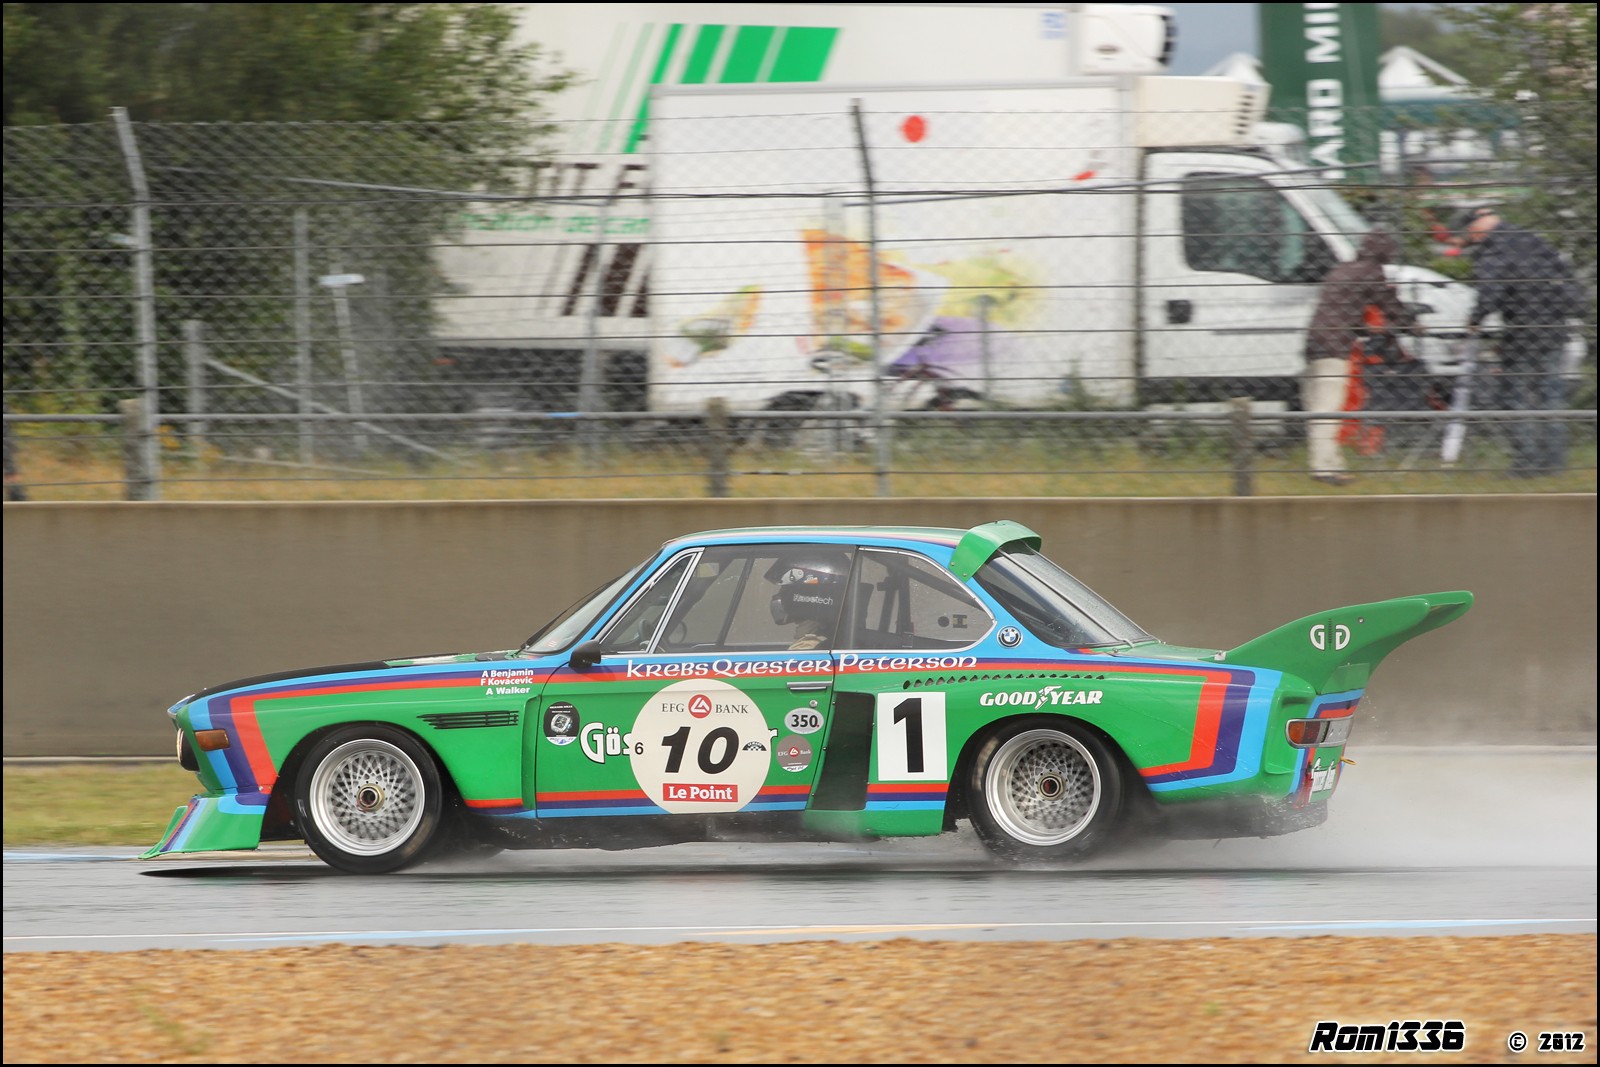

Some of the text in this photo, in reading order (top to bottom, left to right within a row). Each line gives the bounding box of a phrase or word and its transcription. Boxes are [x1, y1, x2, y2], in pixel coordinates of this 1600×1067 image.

[481, 668, 534, 679] A Benjamin
[480, 677, 533, 686] F Kovacevic
[485, 686, 531, 695] A Walker
[661, 703, 749, 714] EFG BANK
[893, 697, 924, 773] 1
[634, 742, 644, 755] 6
[661, 726, 739, 774] 10
[669, 785, 733, 800] Le Point
